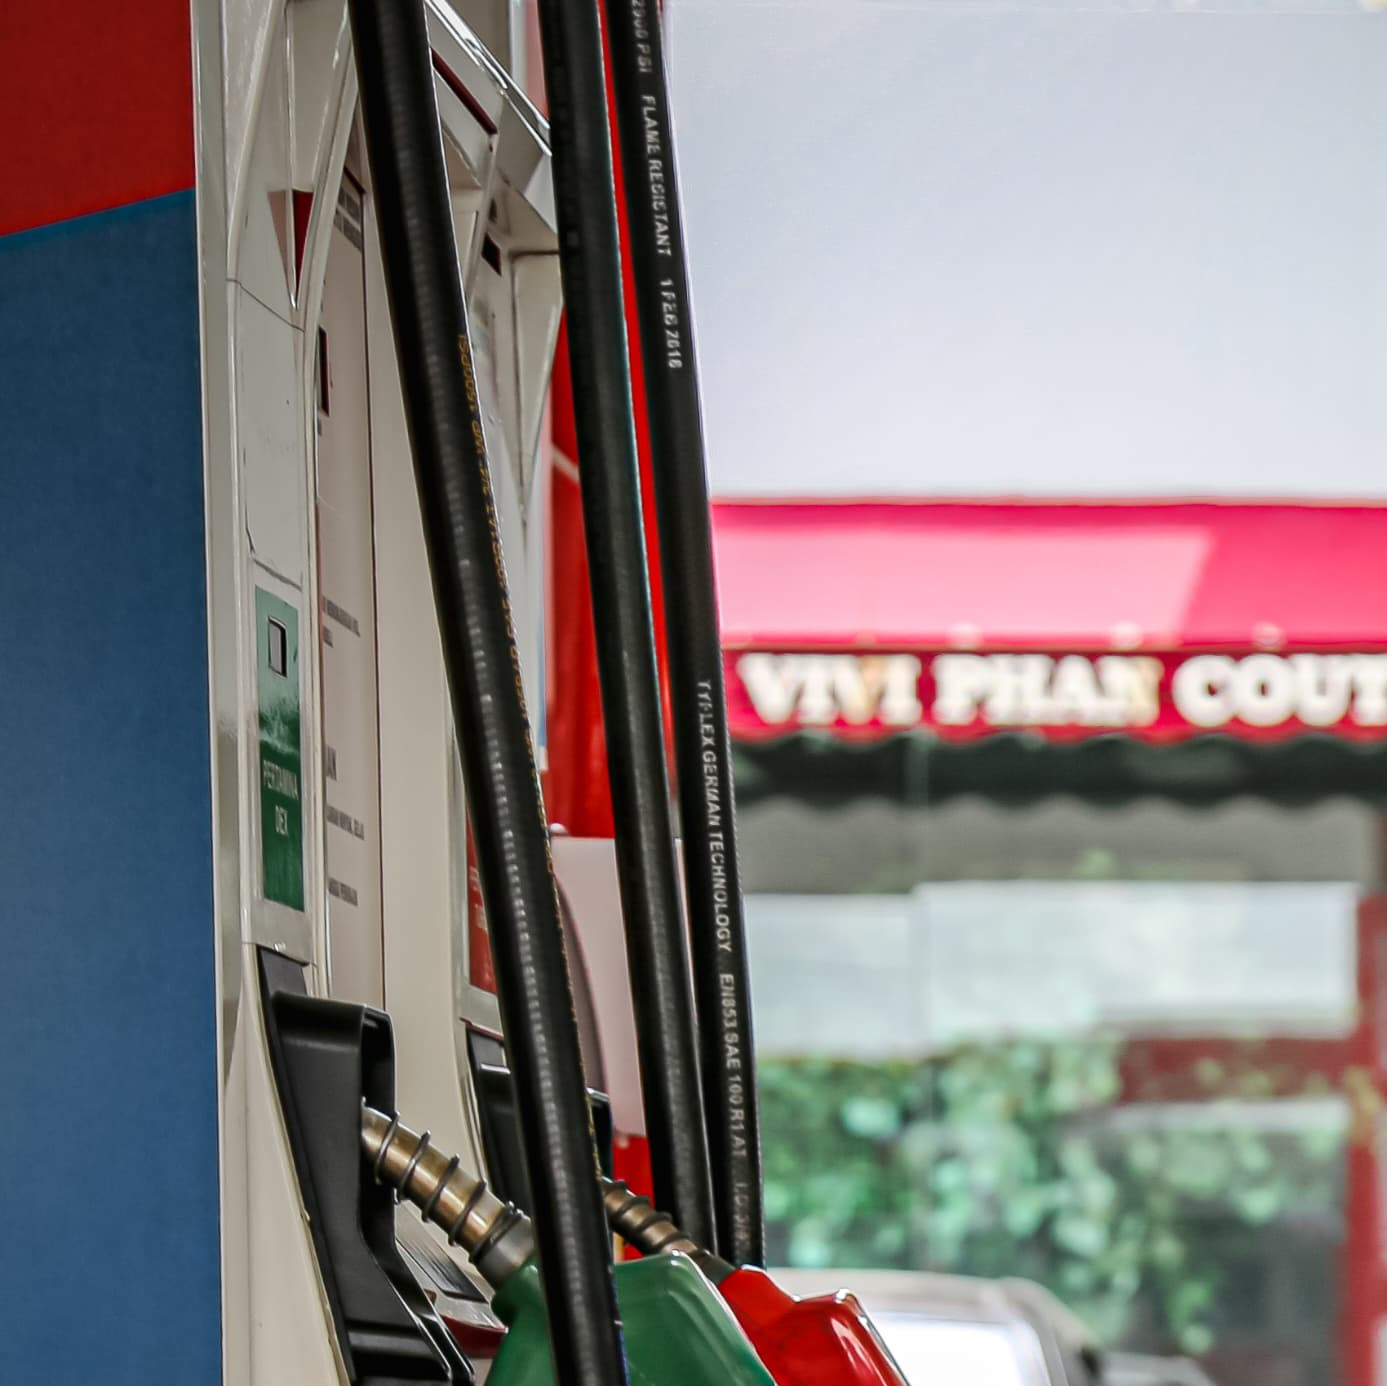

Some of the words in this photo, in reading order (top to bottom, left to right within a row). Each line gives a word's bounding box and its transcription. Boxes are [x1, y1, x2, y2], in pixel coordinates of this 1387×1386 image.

[641, 94, 661, 154] FLAME
[648, 158, 672, 257] RESISTANT
[738, 653, 922, 725] VIVI
[932, 654, 1164, 726] PHAN
[702, 751, 720, 826] GERMAN
[709, 831, 732, 952] TECHNOLOGY
